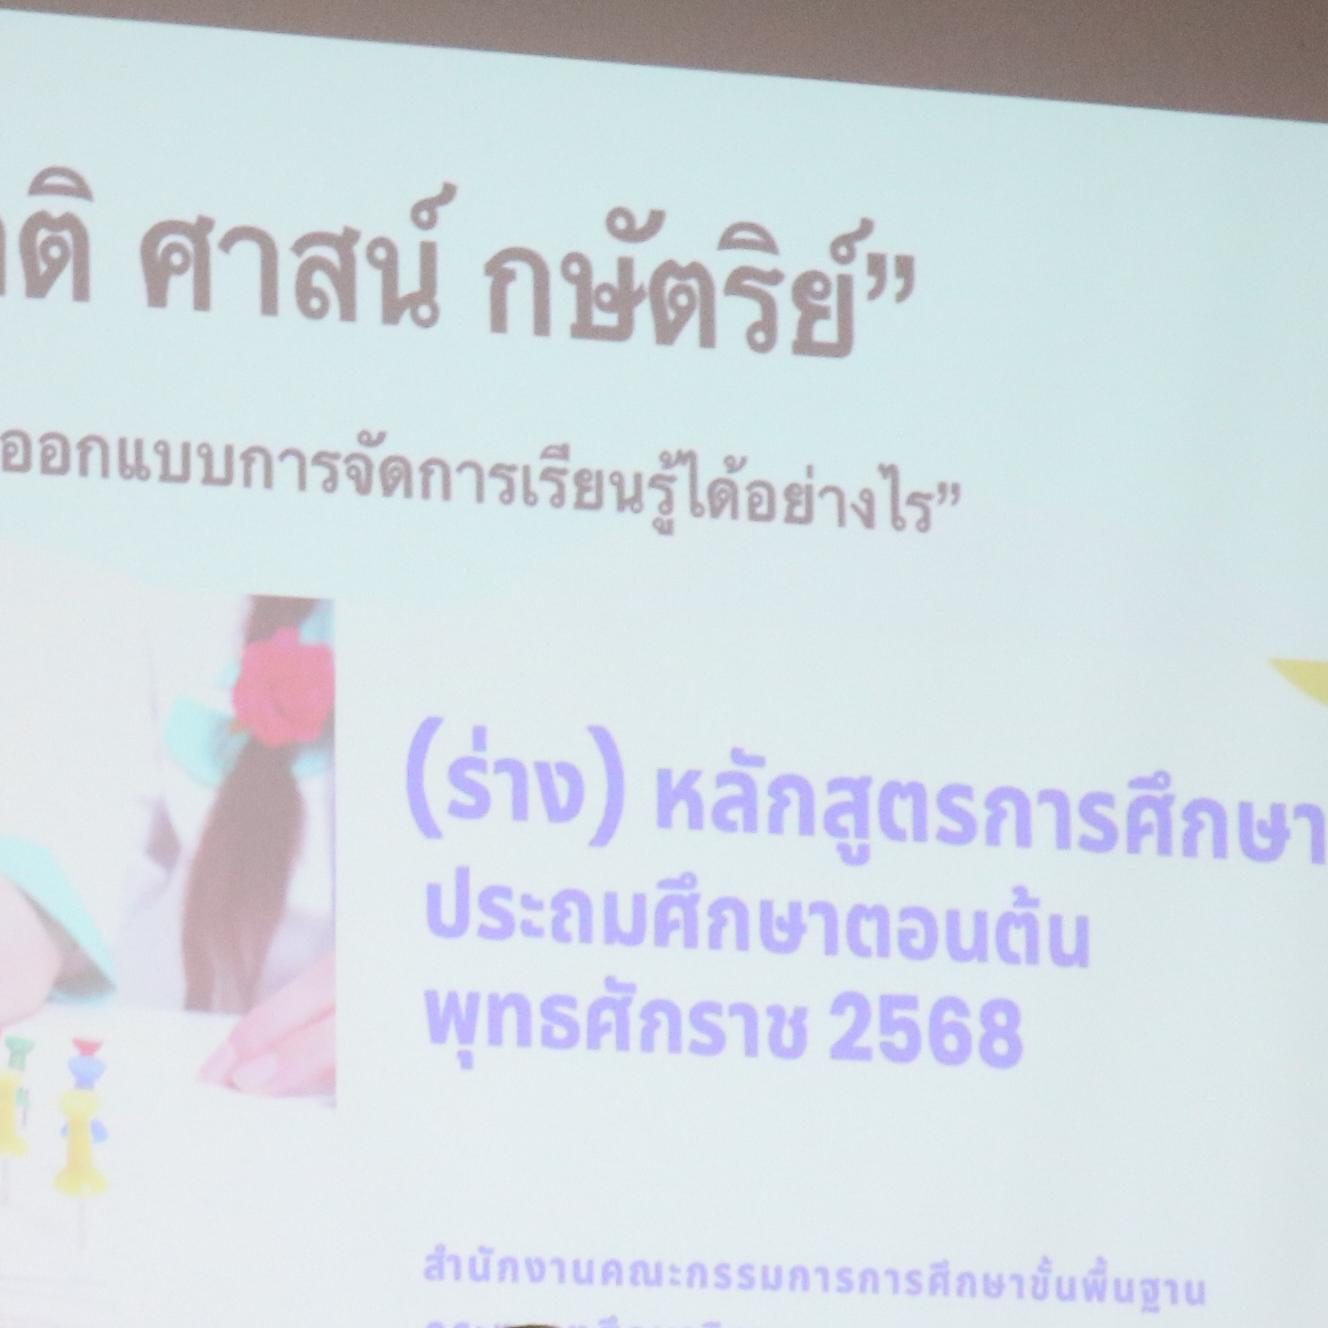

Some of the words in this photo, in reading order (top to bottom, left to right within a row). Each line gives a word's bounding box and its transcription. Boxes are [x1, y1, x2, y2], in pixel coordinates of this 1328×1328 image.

[139, 181, 458, 330] ศาสน์
[483, 206, 916, 359] กษัตริย์”
[405, 715, 626, 848] (ร่าง)
[656, 746, 1328, 867] หลักสูตรการศึกษา
[424, 866, 1091, 969] ประถมศึกษาตอนต้น
[423, 974, 809, 1071] พุทธศักราช
[829, 990, 1025, 1070] 2568
